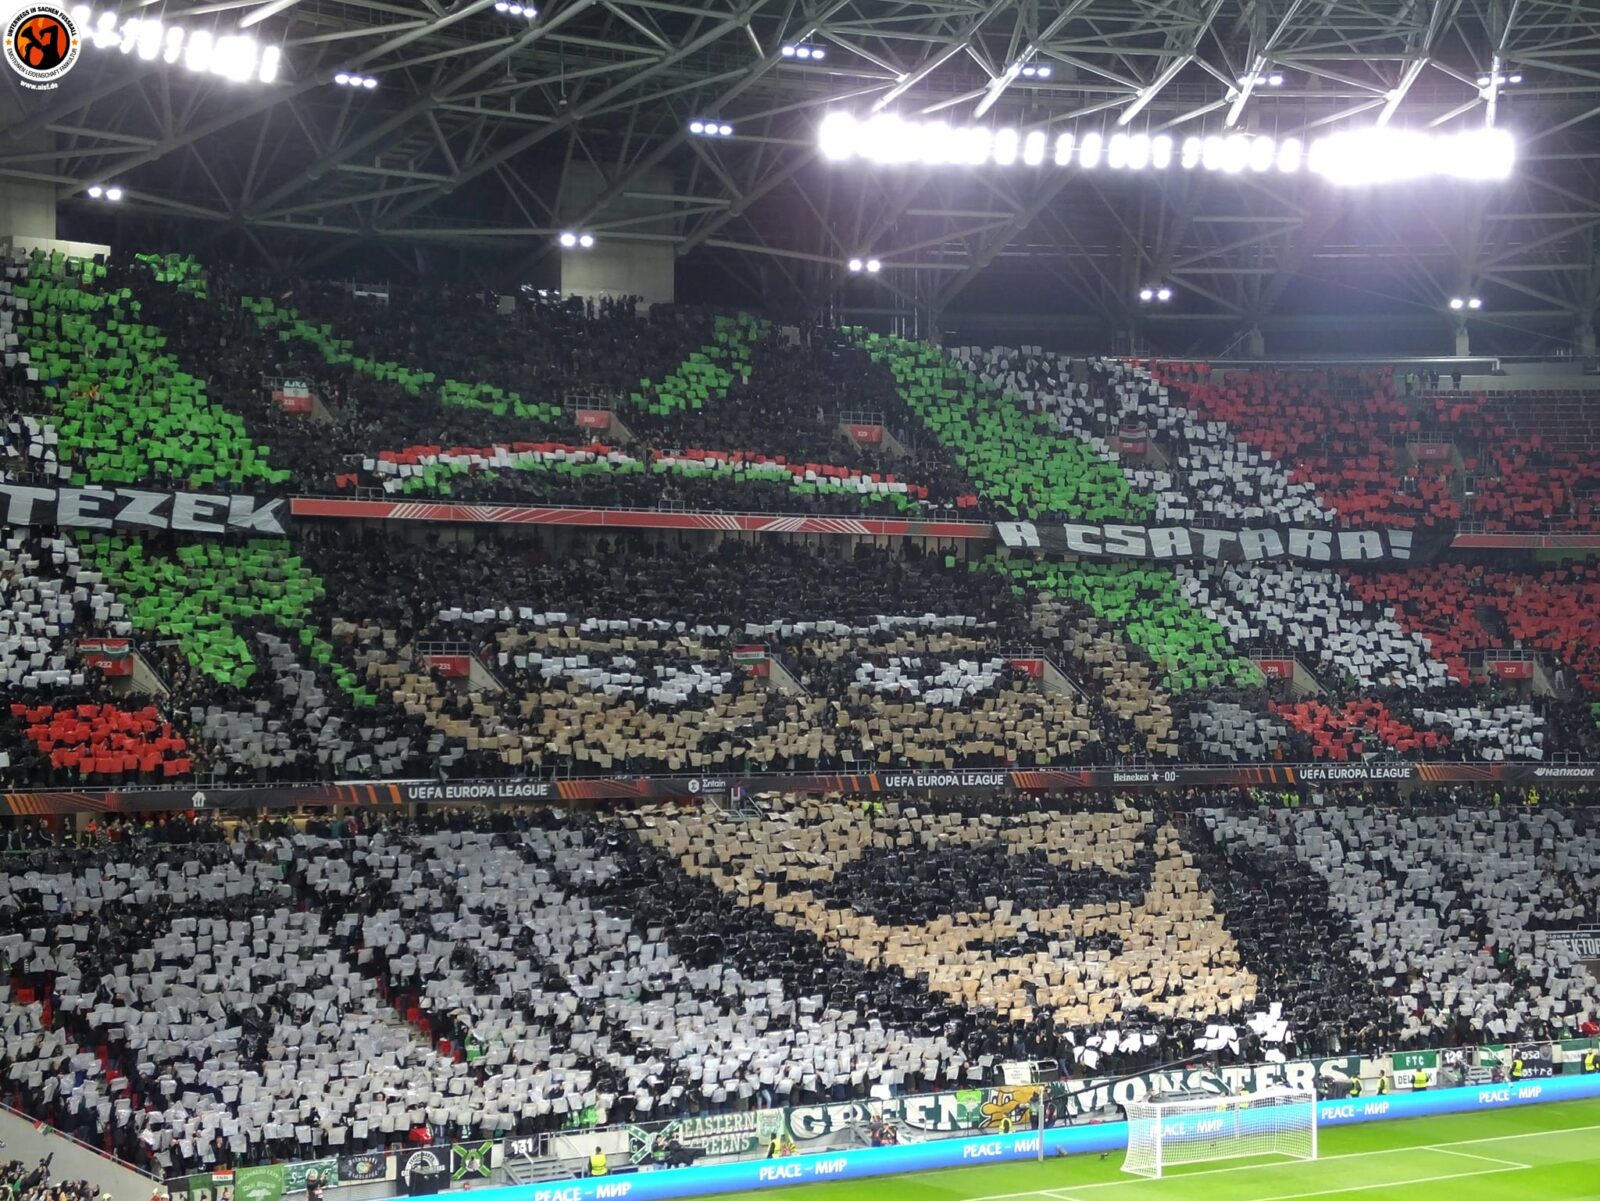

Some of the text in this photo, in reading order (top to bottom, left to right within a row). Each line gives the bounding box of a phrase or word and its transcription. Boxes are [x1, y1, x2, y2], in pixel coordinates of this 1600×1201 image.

[995, 521, 1040, 547] A
[885, 774, 1004, 787] UEFA EUROPA LEAGUE
[1113, 772, 1149, 781] Heineken
[1299, 768, 1410, 779] UEFA EUROPA LEAGUE
[408, 784, 548, 799] UEFA EUROPA LEAGUE
[1405, 1056, 1424, 1067] FTC
[1479, 1088, 1510, 1103] PEACE
[1518, 1086, 1542, 1099] МИР
[1321, 1105, 1355, 1119] PEACE
[1364, 1101, 1389, 1115] МИР
[684, 1109, 756, 1137] EASTERN
[511, 1139, 533, 1154] 131
[963, 1142, 1003, 1158] PEACE
[759, 1163, 802, 1180] PEACE
[815, 1158, 848, 1175] МИР
[534, 1187, 582, 1201] PEACE
[595, 1181, 632, 1199] МИР
